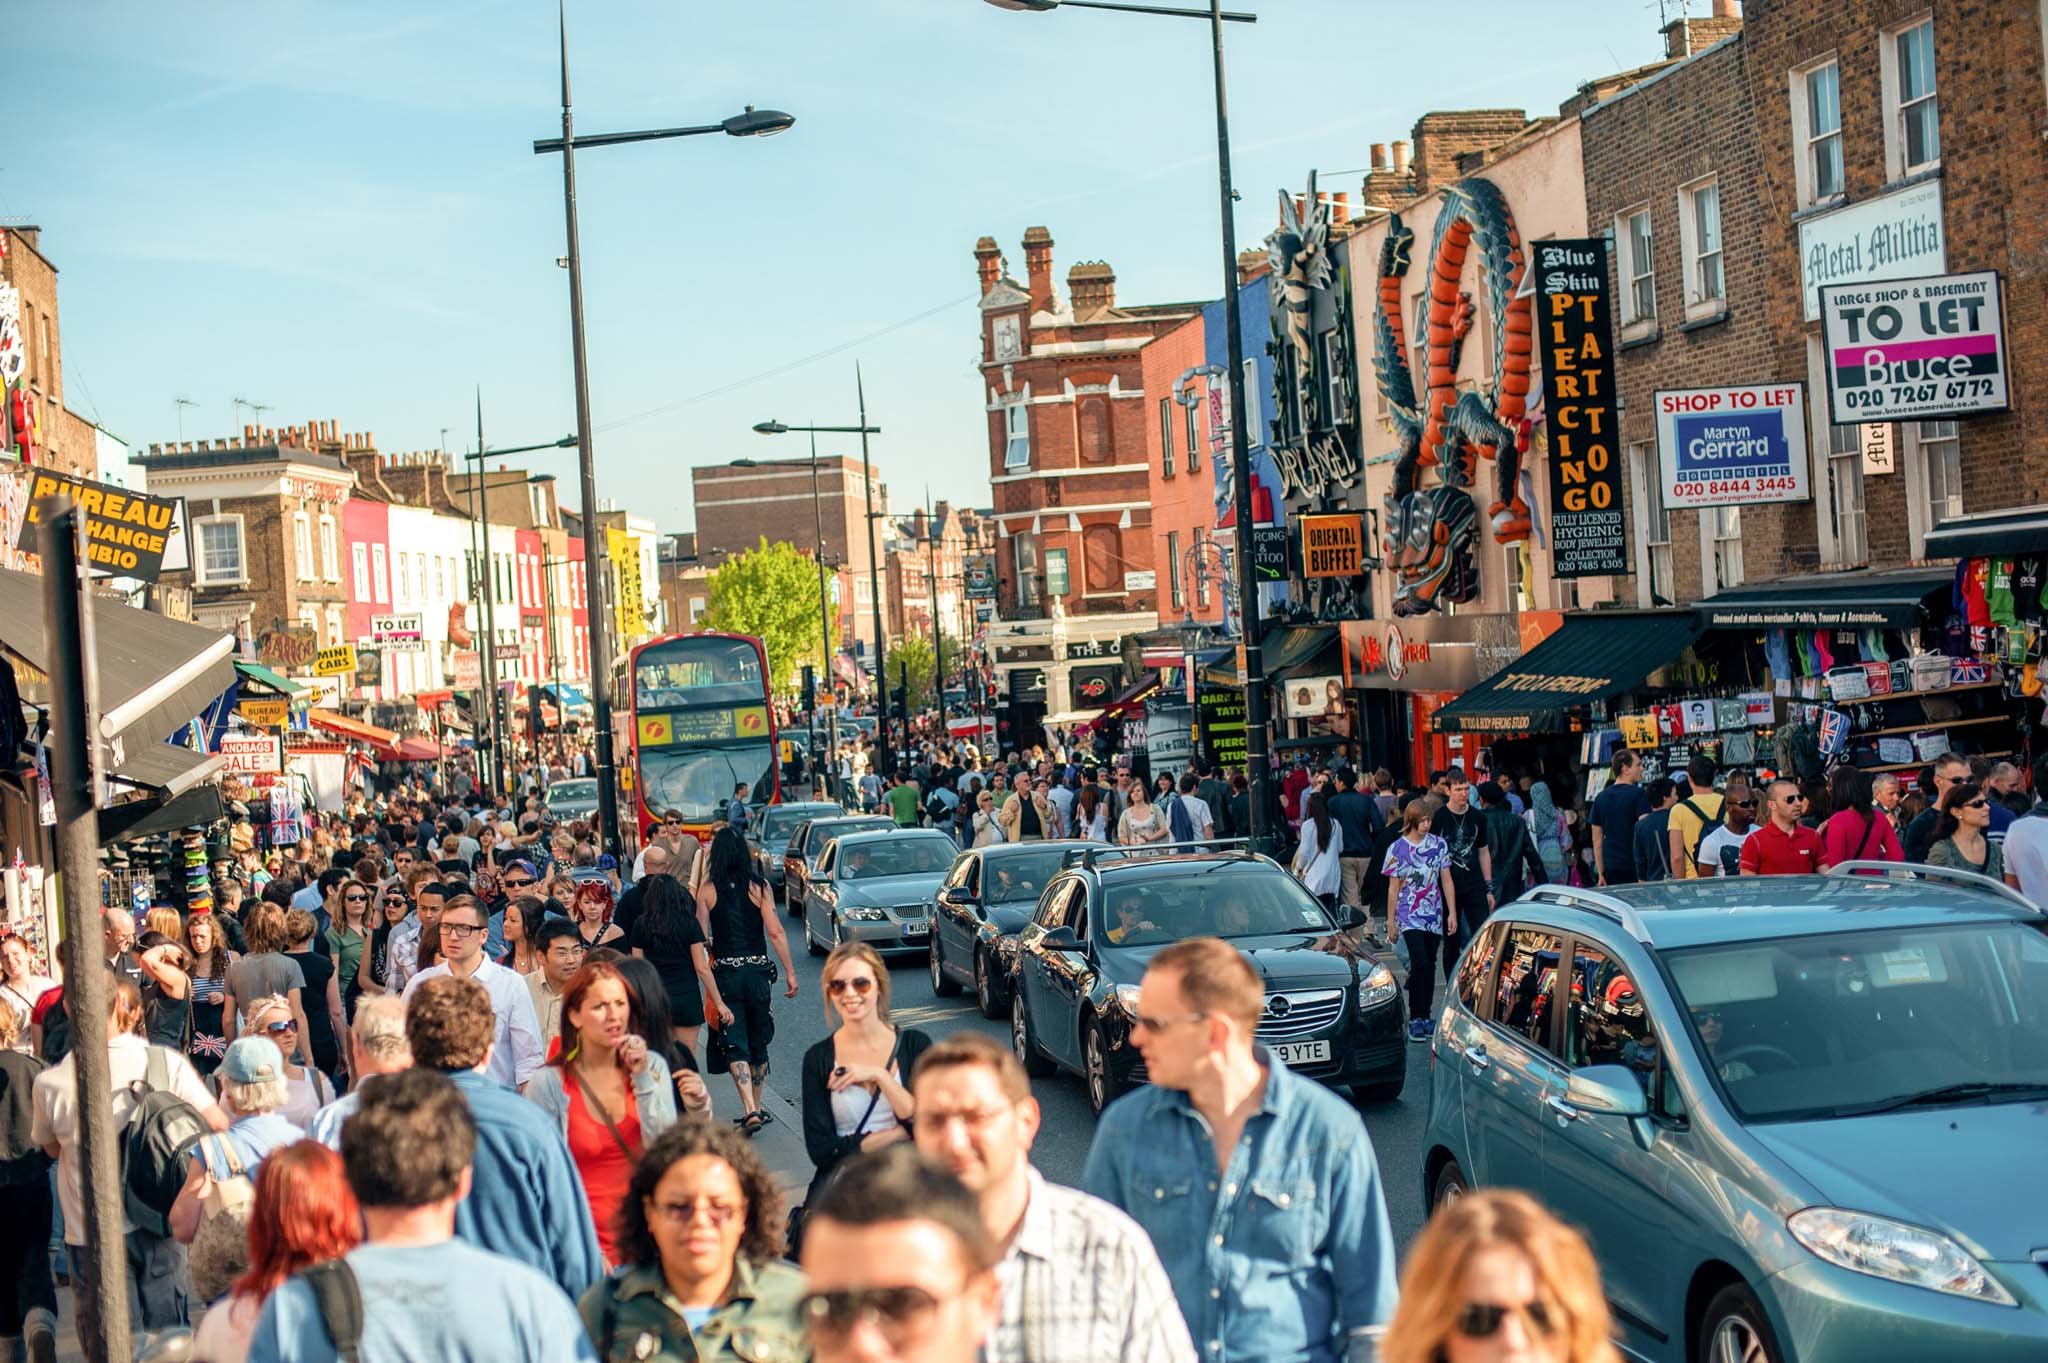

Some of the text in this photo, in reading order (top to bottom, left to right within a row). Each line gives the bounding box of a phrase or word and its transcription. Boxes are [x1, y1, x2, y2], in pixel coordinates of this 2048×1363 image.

[1542, 247, 1596, 268] Blue
[1808, 214, 1940, 288] Metal Militia
[1544, 272, 1600, 295] Skin
[1834, 281, 1988, 306] LARGE SHOP & BASEMENT
[1839, 297, 1985, 343] TO LET
[1864, 349, 1974, 387] Bruce
[1551, 293, 1588, 511] PIERCING
[1577, 295, 1612, 509] TATTOO
[1663, 389, 1796, 413] SHOP TO LET
[1846, 379, 1994, 409] 020 7267 6772
[1862, 400, 1980, 417] www.brucecommercial.co.uk
[1704, 426, 1751, 442] Martyn
[1688, 436, 1769, 461] Gerrard
[1867, 424, 1888, 466] Met
[1678, 467, 1789, 481] COMMERCIAL
[1673, 477, 1796, 497] 020 8444 3445
[34, 476, 172, 531] BUREAU
[1553, 512, 1621, 527] FULLY LICENCED
[82, 519, 166, 554] HANGE
[1310, 528, 1356, 547] ORIENTAL
[1555, 525, 1621, 539] HYGIENIC
[1260, 543, 1267, 552] &
[1554, 537, 1623, 550] BODY JEWELLERY
[1256, 553, 1284, 563] TTOO
[1311, 548, 1356, 572] BUFFET
[1565, 549, 1616, 561] COLLECTION
[1558, 559, 1623, 571] 020 7485 4305
[376, 619, 416, 631] TO LET
[317, 647, 348, 660] MINI
[1073, 645, 1103, 656] THE
[318, 657, 350, 670] CABS
[248, 707, 280, 715] BUREAU
[721, 711, 732, 724] 31
[678, 732, 706, 742] White
[223, 742, 271, 753] ANDBAGS
[1293, 1042, 1323, 1060] YTE
